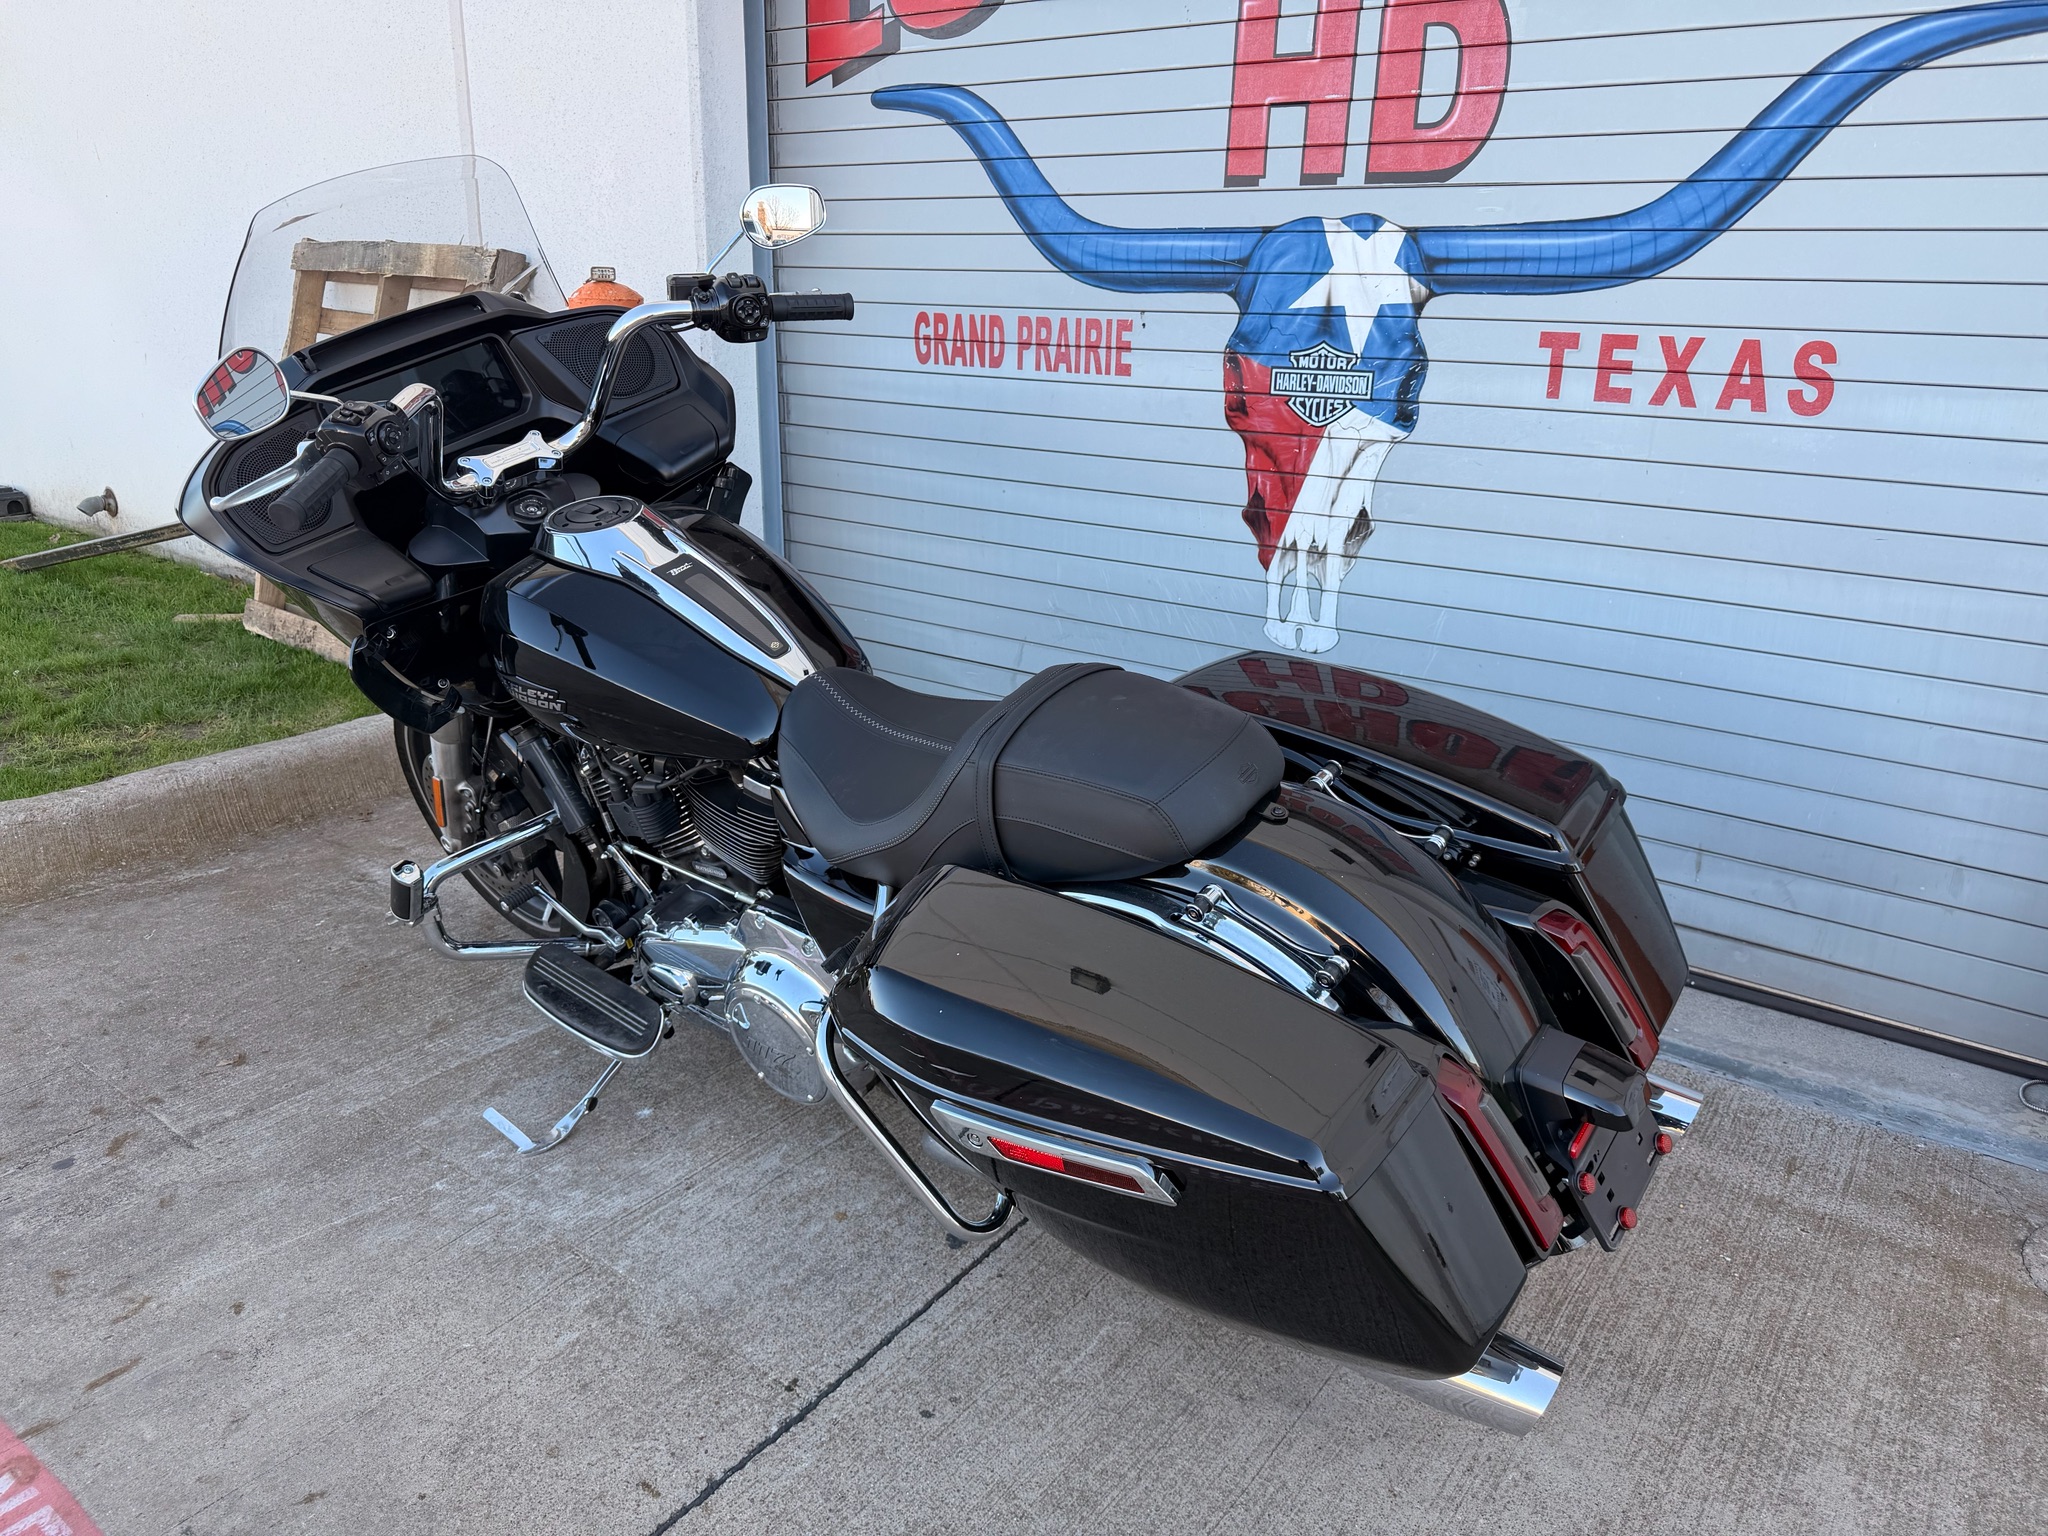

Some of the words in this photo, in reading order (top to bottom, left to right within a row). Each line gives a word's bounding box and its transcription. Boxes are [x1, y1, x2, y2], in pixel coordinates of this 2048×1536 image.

[1225, 0, 1511, 187] HD
[914, 311, 1005, 369] GRAND
[1016, 315, 1134, 377] PRAIRIE
[1299, 349, 1347, 370] MOTOR
[1275, 373, 1369, 395] HARLEY-DAVIDSON
[1538, 330, 1839, 418] TEXAS
[1295, 397, 1344, 422] CYCLES
